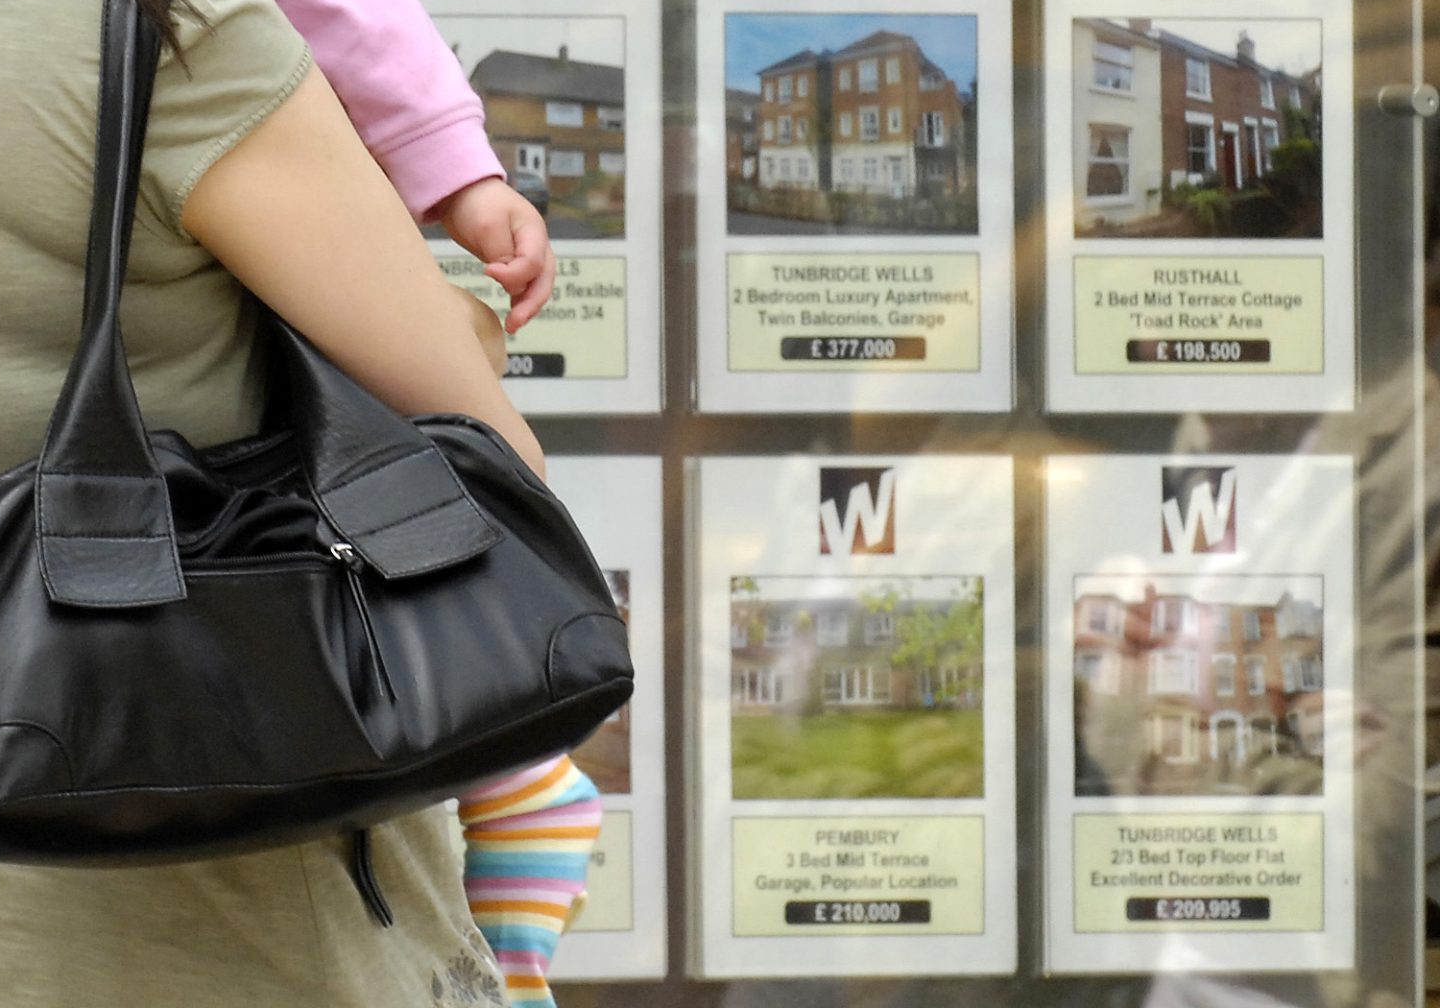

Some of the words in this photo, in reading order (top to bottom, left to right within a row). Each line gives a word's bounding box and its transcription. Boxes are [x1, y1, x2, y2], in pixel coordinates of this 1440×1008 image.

[773, 267, 869, 281] TUNBRIDGE
[876, 267, 933, 282] WELLS
[1154, 270, 1241, 285] RUSTHALL
[566, 283, 624, 298] flexible
[734, 289, 742, 304] 2
[747, 288, 820, 304] Bedroom
[826, 290, 880, 307] Luxury
[886, 290, 973, 306] Apartment,
[1095, 292, 1102, 306] 2
[1109, 292, 1138, 306] Bed
[1144, 292, 1171, 305] Mid
[1178, 291, 1236, 306] Terrace
[1242, 292, 1302, 310] Cottage
[582, 306, 603, 319] 3/4
[758, 310, 795, 325] Twin
[801, 310, 881, 326] Balconies,
[888, 310, 944, 328] Garage
[1130, 313, 1173, 328] 'Toad
[1179, 314, 1222, 328] Rock'
[1228, 314, 1262, 328] Area
[811, 340, 822, 357] £
[1157, 343, 1167, 359] £
[1175, 343, 1240, 361] 198,500
[816, 830, 898, 846] PEMBURY
[1117, 827, 1216, 843] TUNBRIDGE
[1222, 827, 1276, 842] WELLS
[787, 853, 795, 868] 3
[800, 853, 831, 868] Bed
[837, 853, 864, 866] Mid
[872, 852, 929, 867] Terrace
[1111, 849, 1133, 864] 2/3
[1139, 849, 1170, 864] Bed
[1177, 849, 1206, 867] Top
[1210, 848, 1250, 864] Floor
[1256, 849, 1285, 864] Flat
[755, 875, 816, 894] Garage,
[821, 874, 883, 892] Popular
[889, 875, 958, 889] Location
[1091, 871, 1163, 887] Excellent
[1169, 871, 1252, 886] Decorative
[1257, 872, 1301, 886] Order
[815, 903, 826, 920] £
[1156, 901, 1168, 918] £
